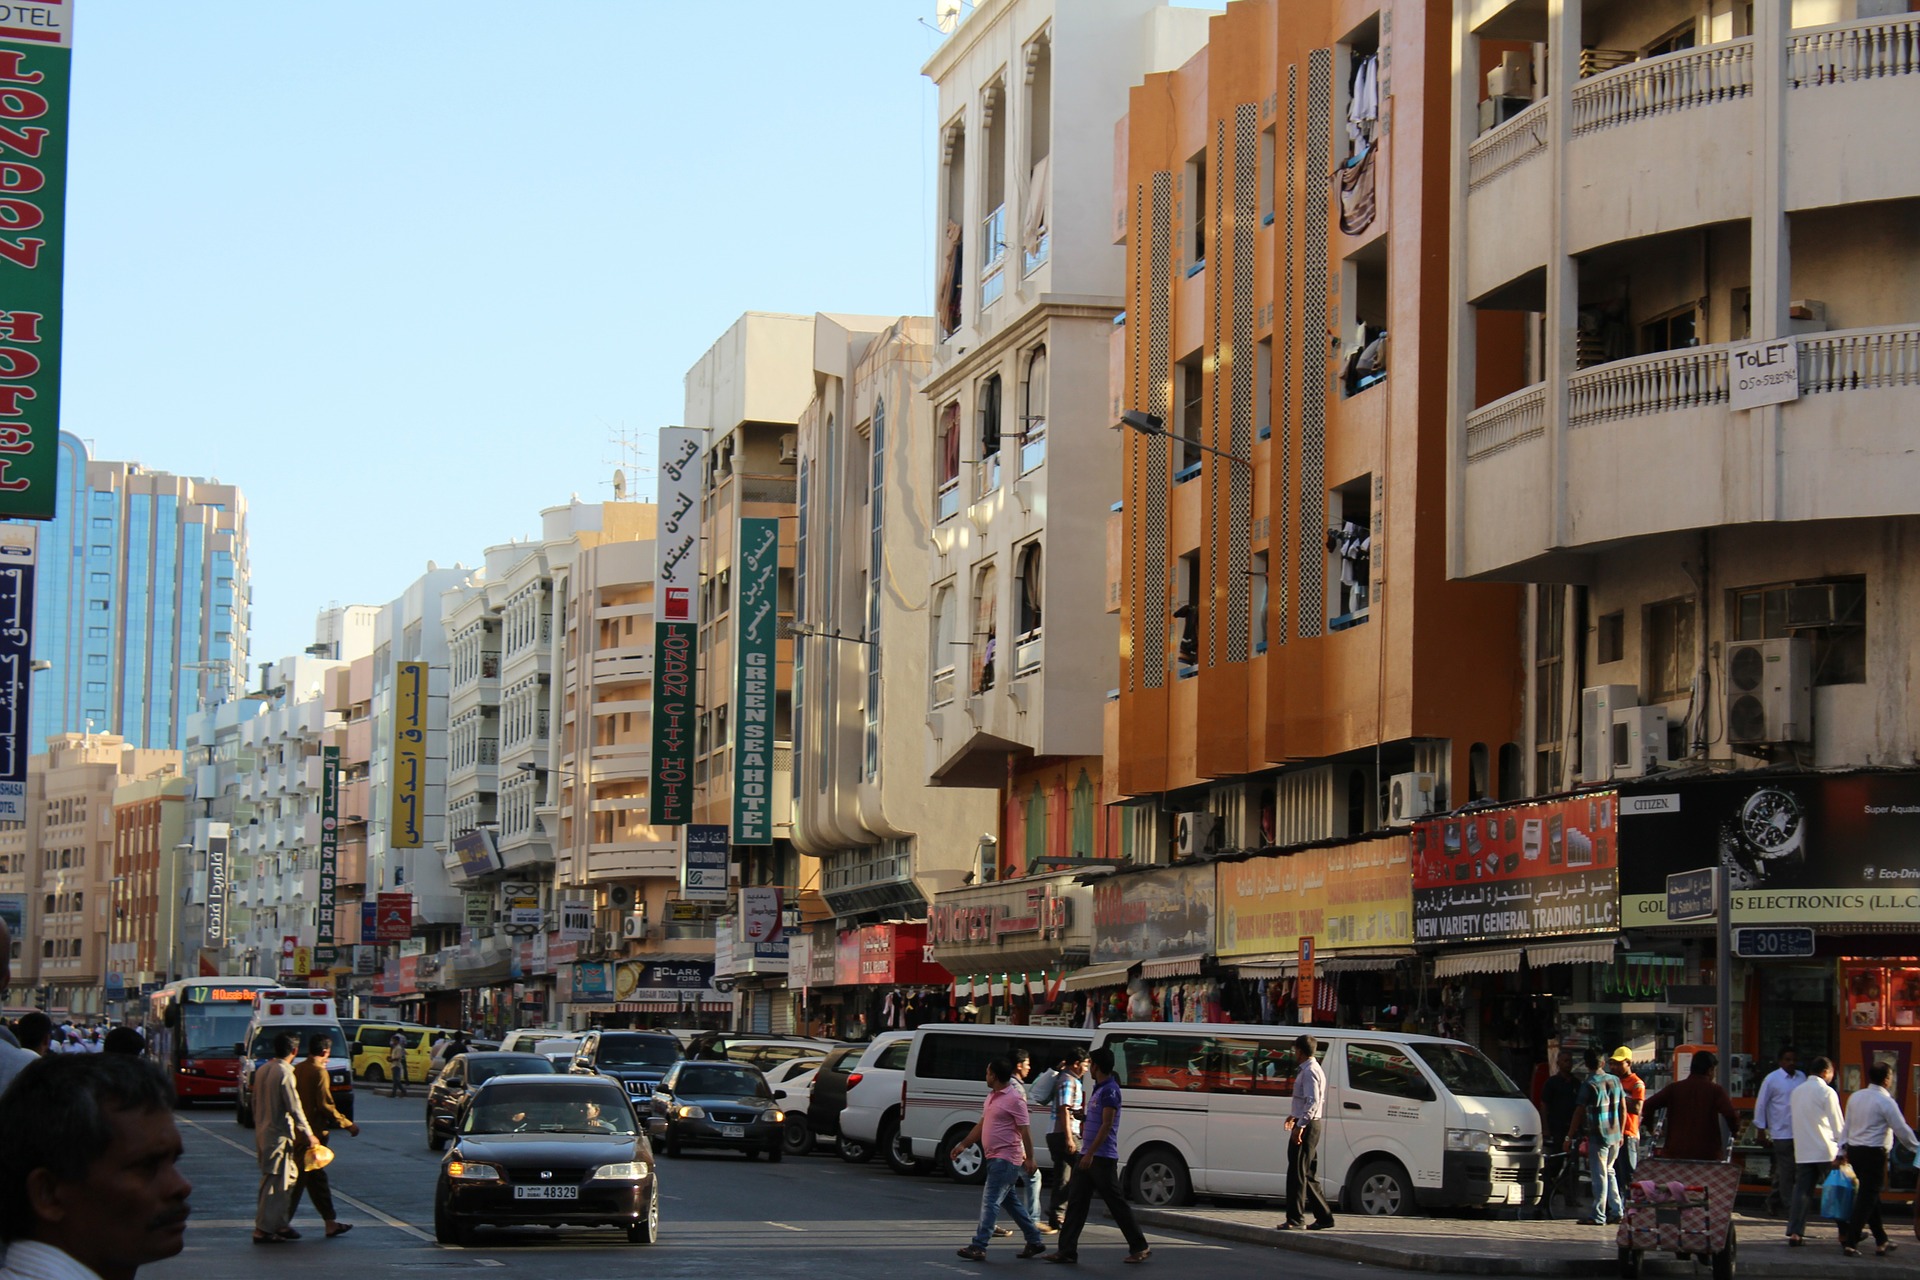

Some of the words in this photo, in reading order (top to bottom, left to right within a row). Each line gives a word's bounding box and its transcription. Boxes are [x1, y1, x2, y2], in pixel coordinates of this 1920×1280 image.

[663, 438, 699, 482] فندق
[665, 491, 694, 534] لندن
[661, 534, 694, 583] سيتي
[743, 526, 776, 572] فندق
[663, 625, 689, 696] LONDON
[399, 664, 423, 743] فندق
[663, 702, 685, 751] CITY
[659, 757, 686, 820] HOTEL
[741, 769, 766, 839] HOTEL
[1634, 798, 1669, 810] CITIZEN
[1864, 804, 1889, 815] Super
[319, 846, 335, 938] SABKHA
[1534, 873, 1586, 906] فيرايتي
[1588, 873, 1613, 897] نيو
[1749, 894, 1864, 910] ELECTRONICS
[1417, 917, 1438, 938] NEW
[1440, 914, 1480, 936] VARIETY
[1483, 909, 1531, 933] GENERAL
[1532, 904, 1582, 929] TRADING
[1584, 901, 1613, 925] L.L.C
[1757, 933, 1777, 952] 30
[662, 967, 700, 976] CLARK
[195, 987, 208, 1003] 17
[518, 1187, 523, 1197] D
[543, 1187, 576, 1198] 48329
